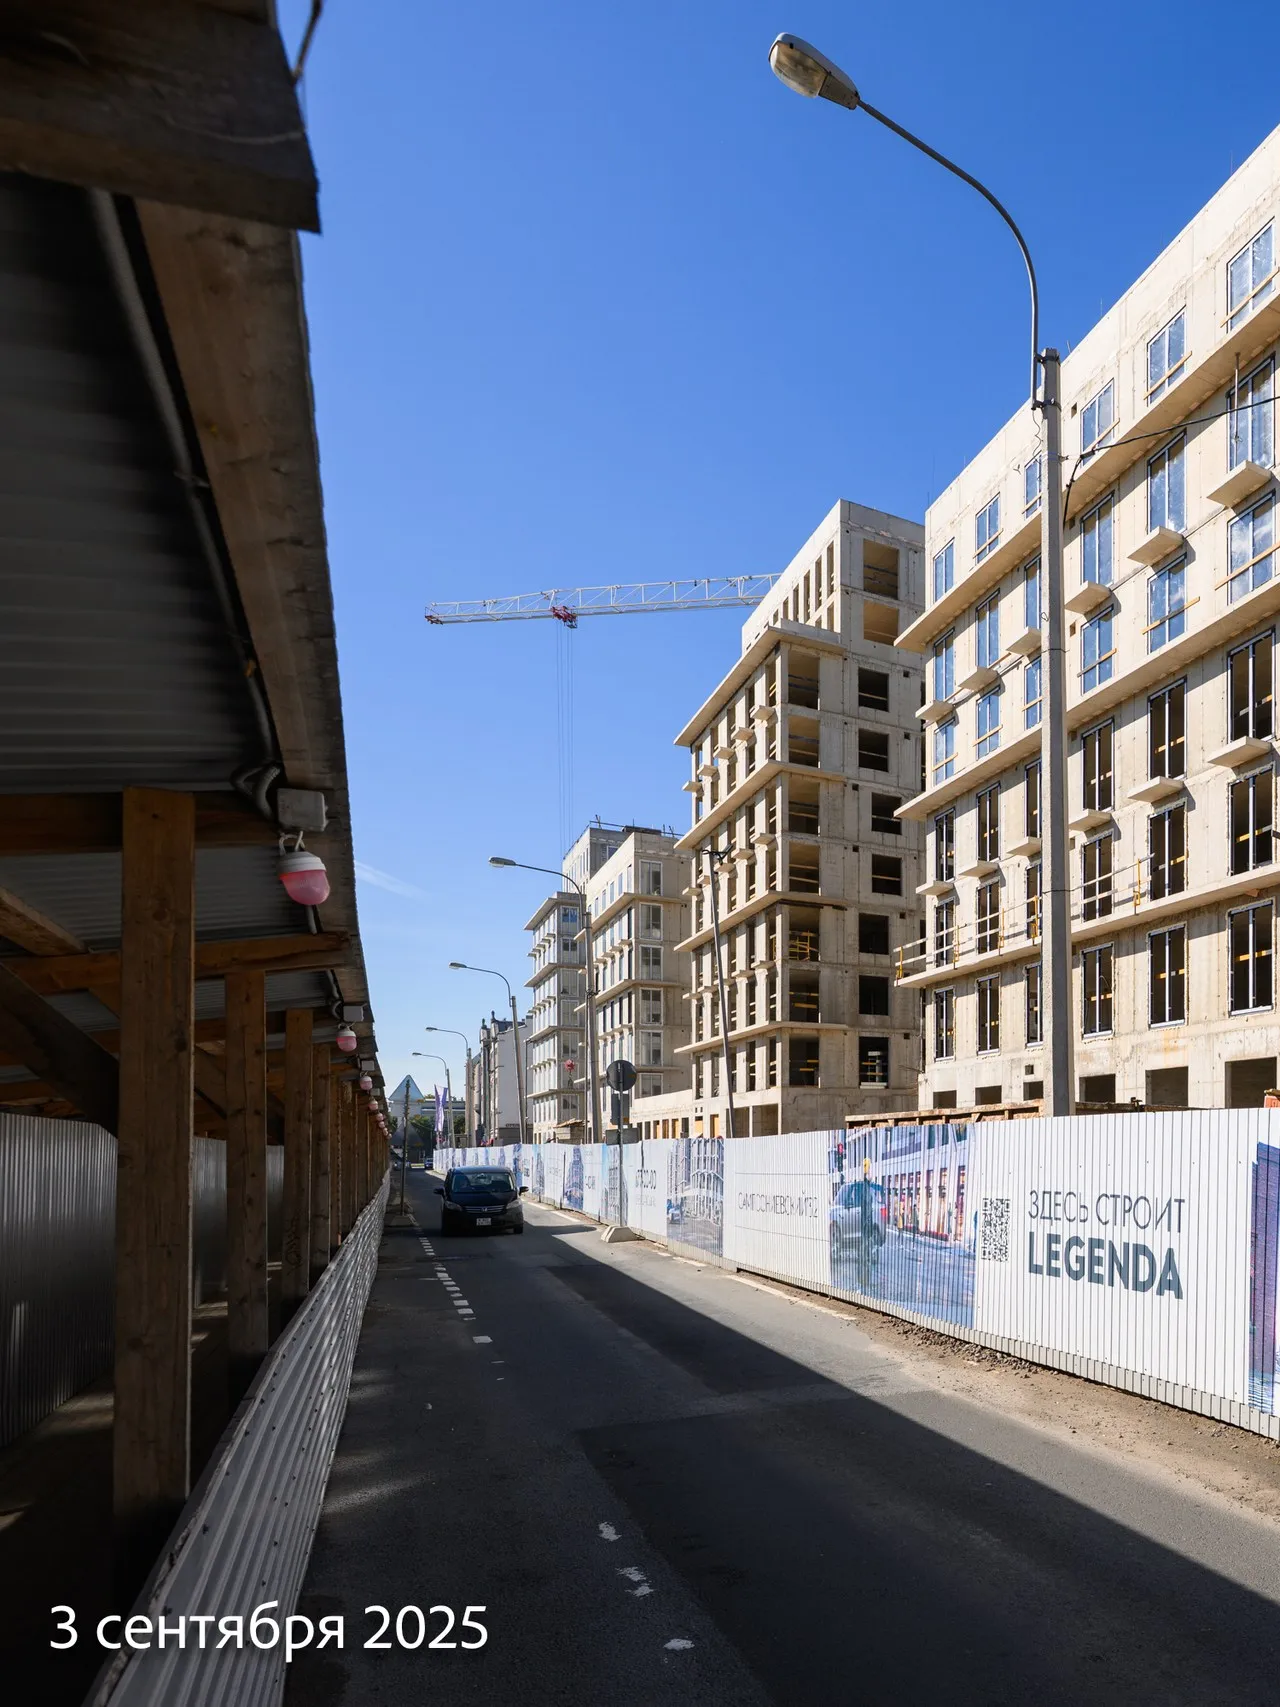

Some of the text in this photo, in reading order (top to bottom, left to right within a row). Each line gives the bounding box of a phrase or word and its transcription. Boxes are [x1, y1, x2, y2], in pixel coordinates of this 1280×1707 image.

[1028, 1189, 1185, 1233] ЗДЕСЬ СТРОИТ
[1028, 1231, 1184, 1300] LEGENDA
